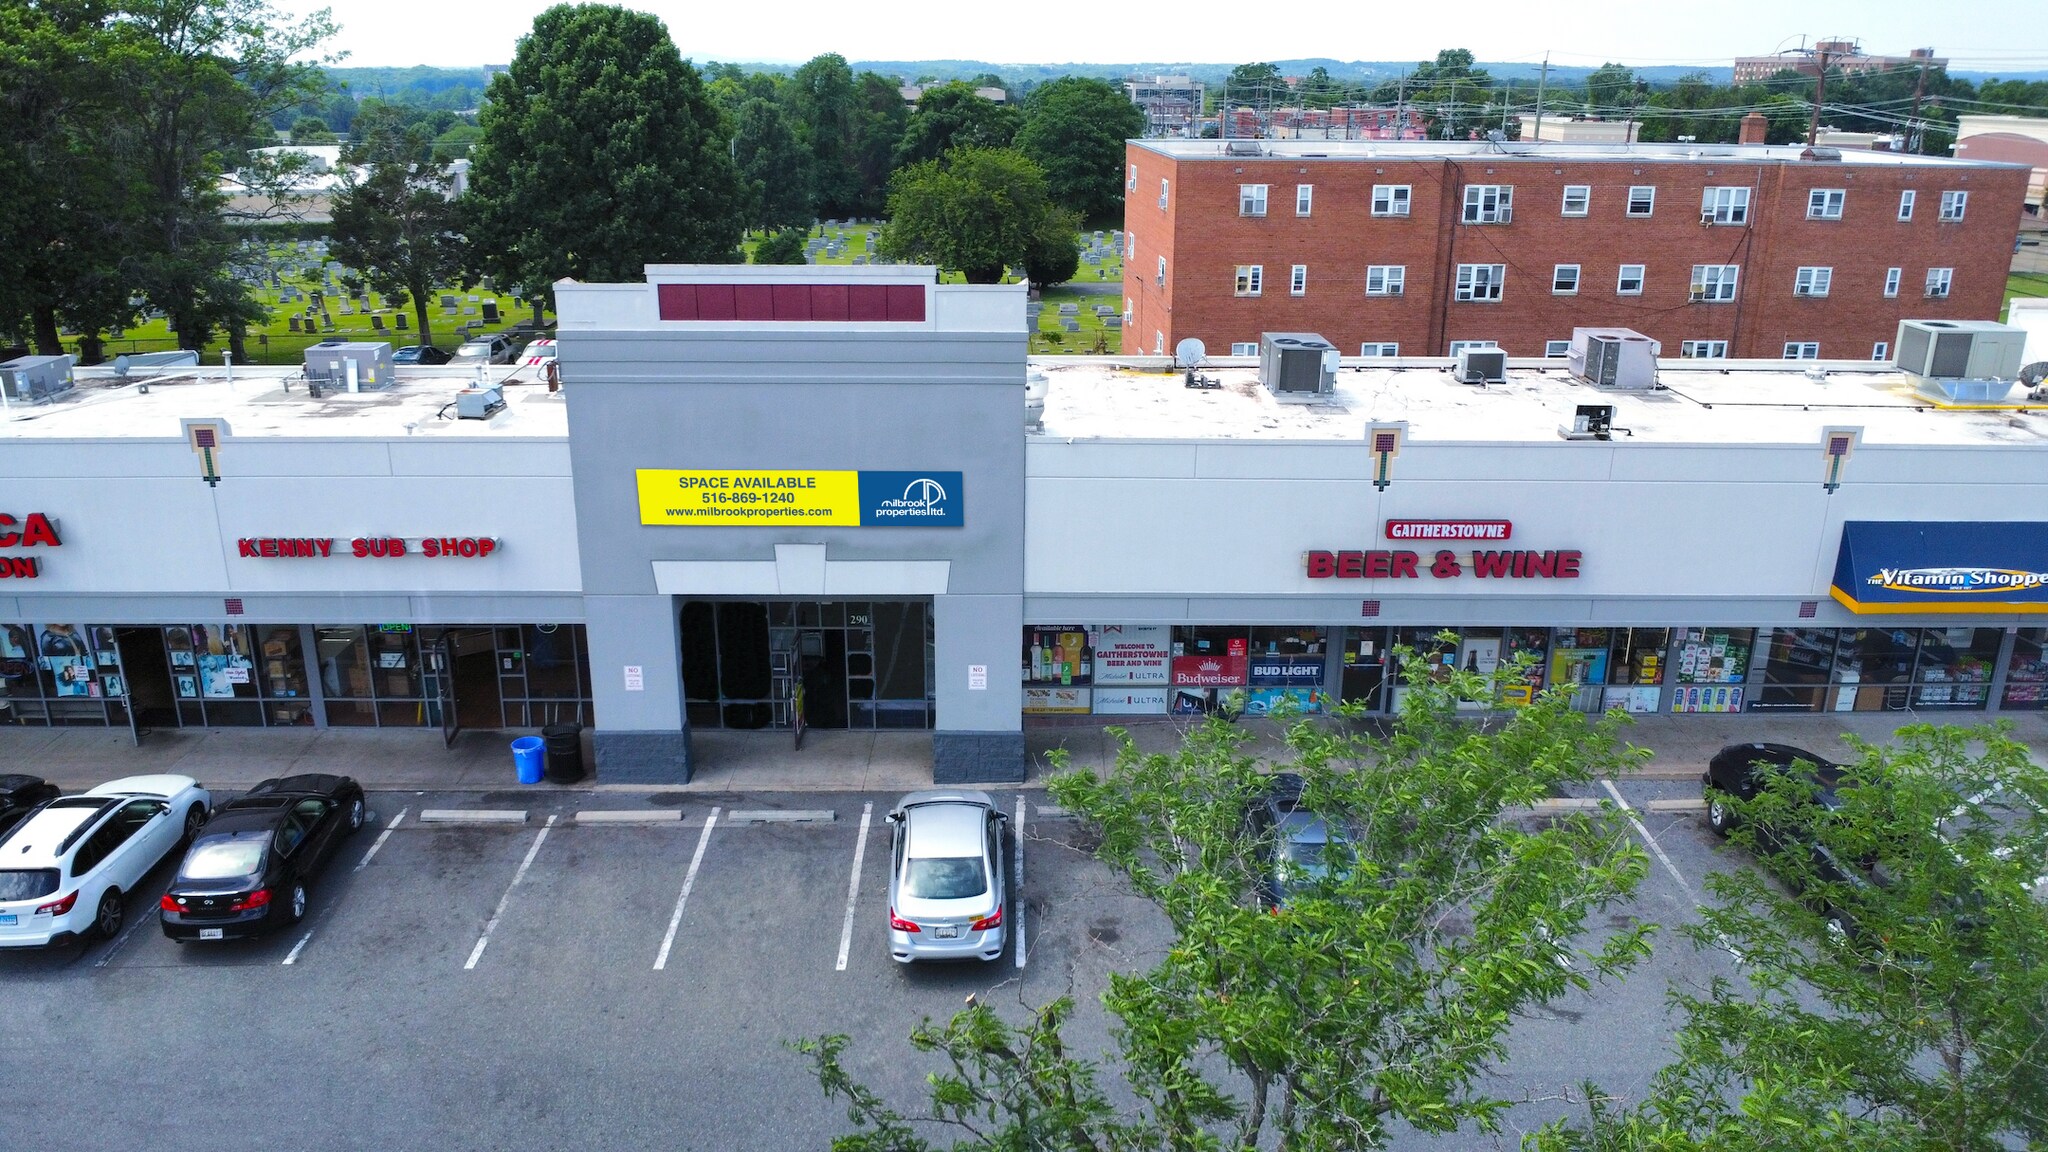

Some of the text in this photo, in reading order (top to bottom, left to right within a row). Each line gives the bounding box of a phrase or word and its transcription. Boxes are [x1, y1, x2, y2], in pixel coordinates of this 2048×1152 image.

[679, 476, 816, 489] SPACE AVAILABLE
[702, 492, 795, 504] 516-869-1240
[881, 498, 926, 508] milbrook
[665, 507, 833, 518] www.milbrookproperties.com
[875, 507, 946, 518] properties ltd.
[1391, 523, 1507, 538] GAITHERSTOWNE
[238, 537, 498, 558] KENNY SUB SHOP
[1307, 550, 1583, 579] BEER & WINE
[1880, 568, 1966, 586] Vitamin
[850, 615, 868, 625] 290
[382, 623, 408, 631] OPEN
[1096, 650, 1168, 659] GAITHERSTOWNE
[1135, 672, 1165, 680] ULTRA
[1253, 666, 1319, 676] BUD LIGHT
[1176, 673, 1241, 684] Budweiser
[1133, 696, 1165, 704] ULTRA
